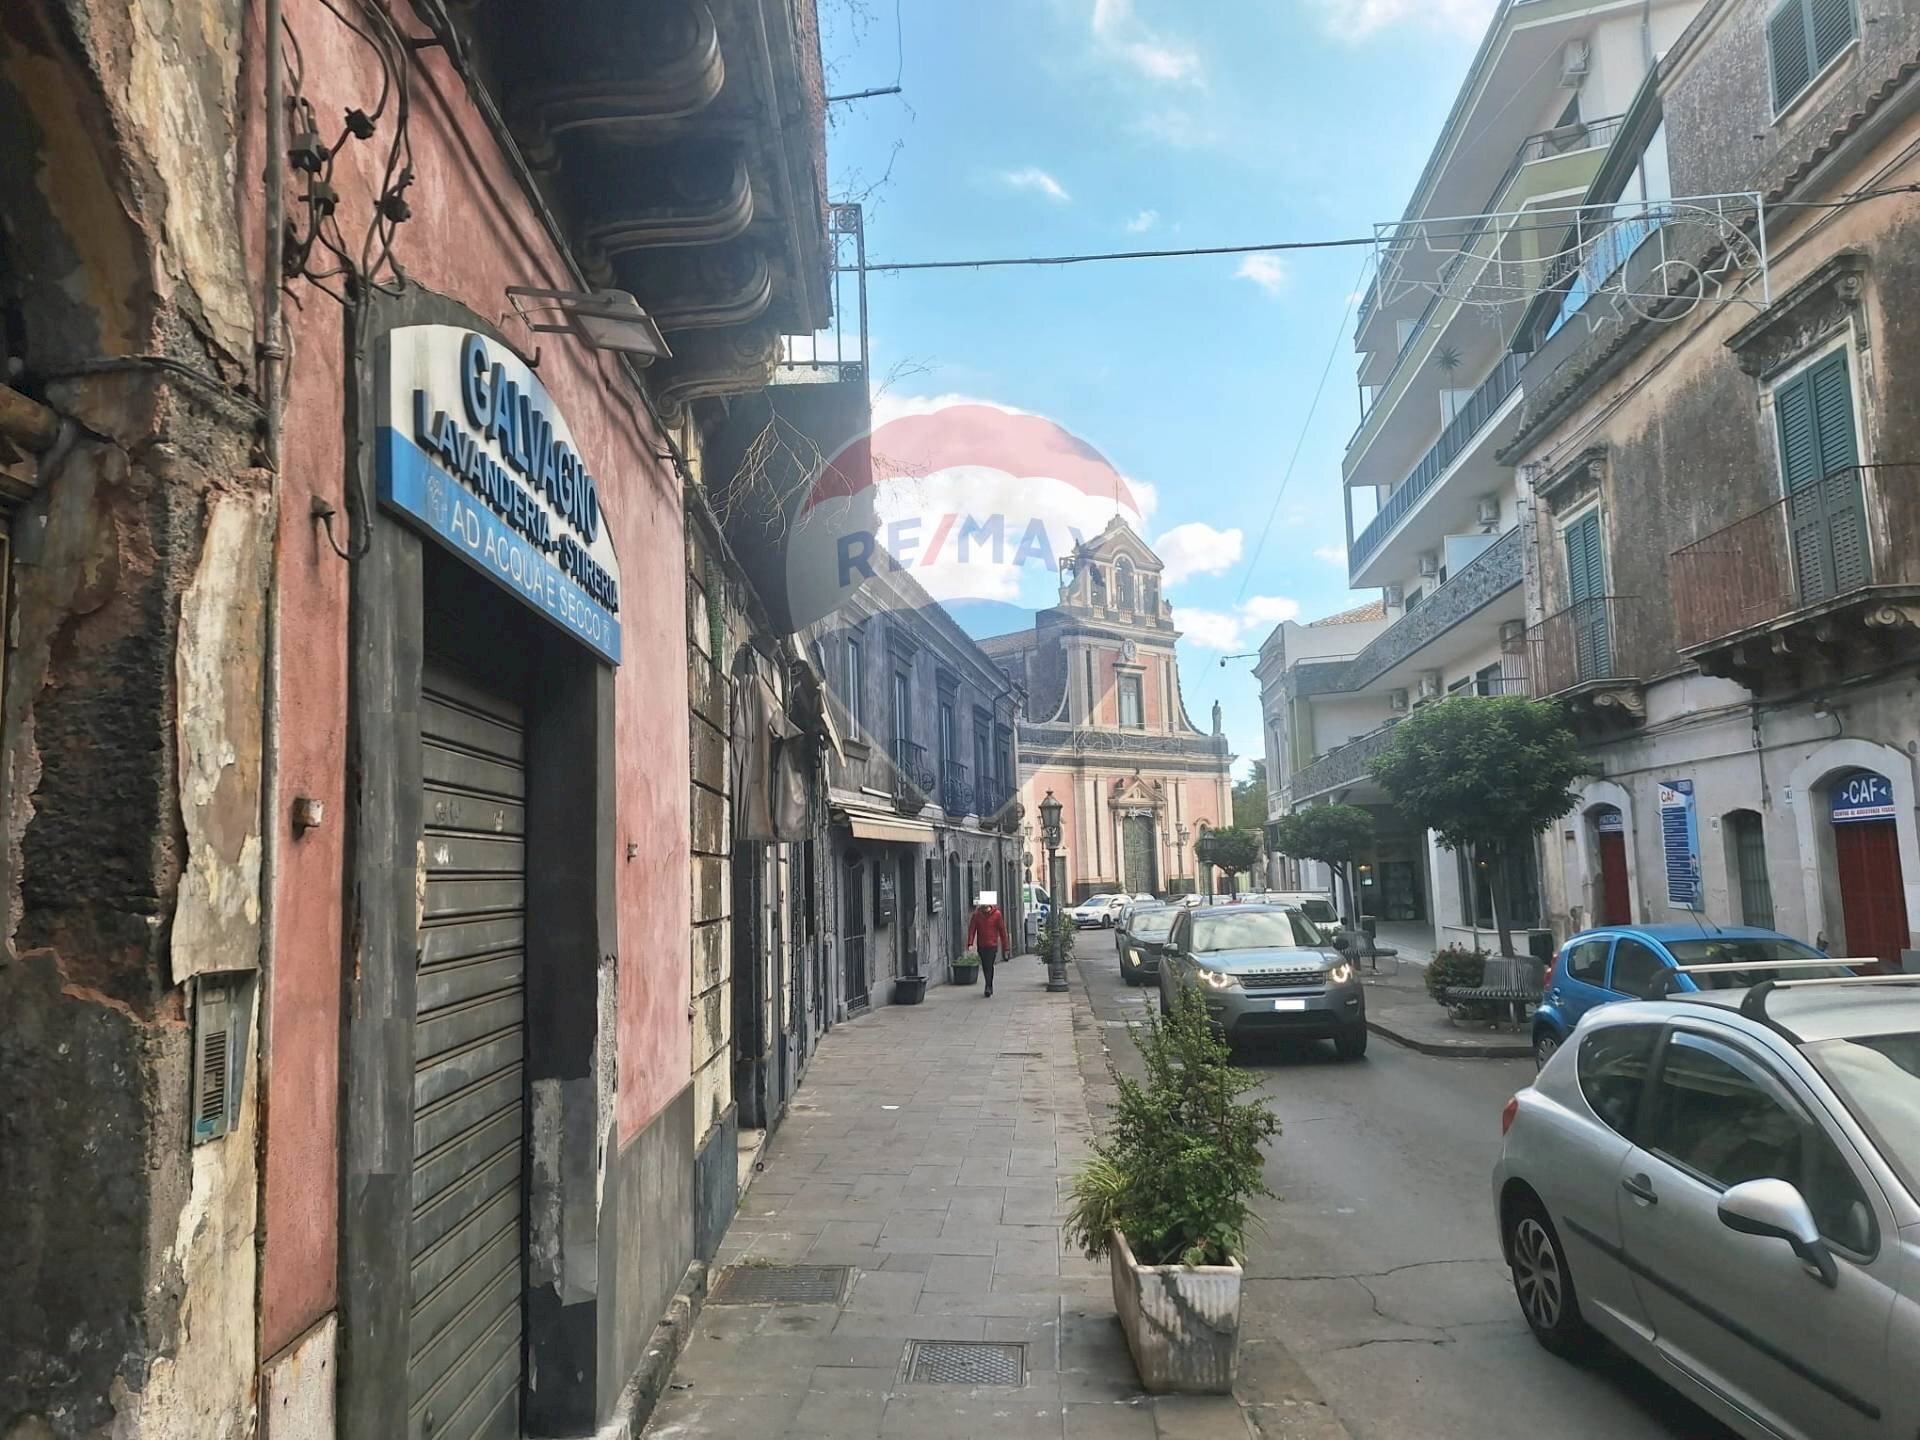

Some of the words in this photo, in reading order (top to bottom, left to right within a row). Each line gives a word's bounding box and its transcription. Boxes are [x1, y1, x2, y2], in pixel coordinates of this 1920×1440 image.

[414, 389, 552, 552] LAVANDERIA
[559, 533, 619, 612] STIRERIA
[462, 333, 599, 544] GALVAGNO
[451, 500, 480, 548] AD
[484, 526, 544, 600] ACQUA
[546, 576, 556, 608] E
[559, 585, 601, 641] SECCO
[1661, 790, 1675, 803] CAF
[1848, 777, 1878, 804] CAF
